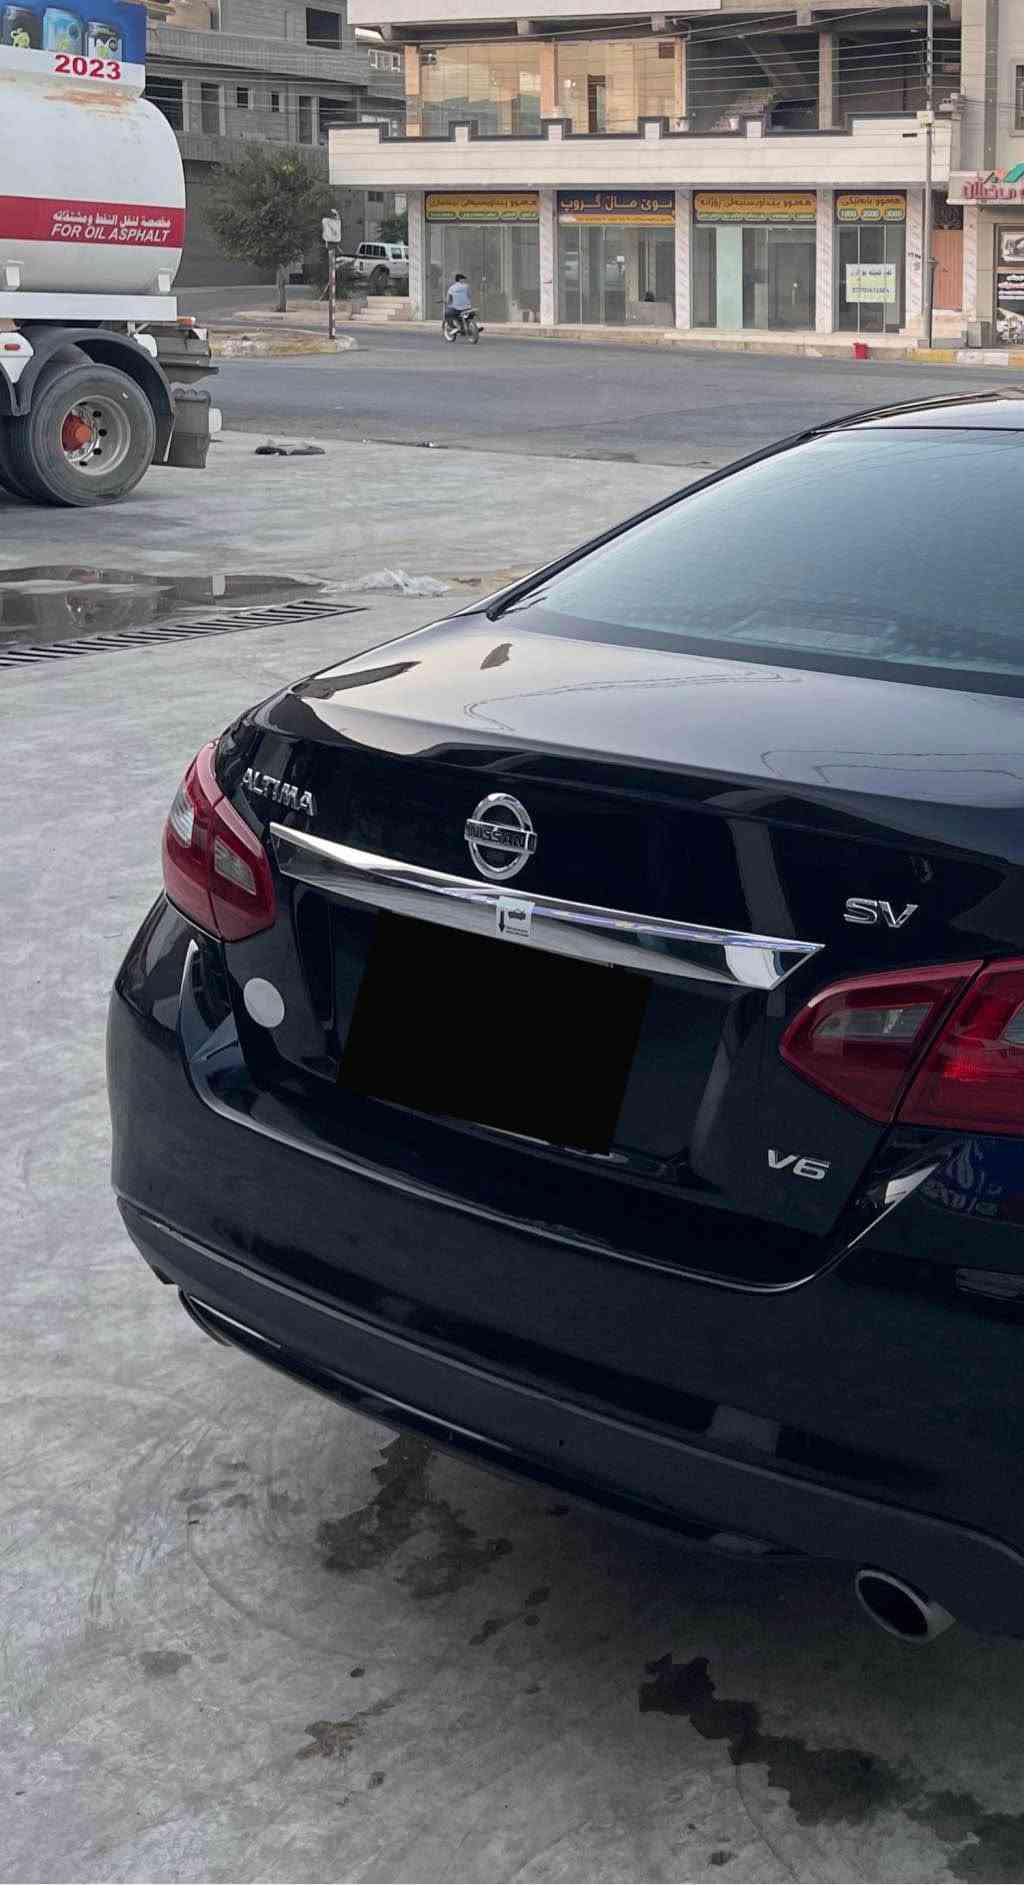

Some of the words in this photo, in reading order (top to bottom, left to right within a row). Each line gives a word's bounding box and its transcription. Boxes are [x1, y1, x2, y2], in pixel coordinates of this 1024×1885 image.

[54, 53, 121, 81] 2023
[51, 223, 82, 238] FOR
[84, 225, 107, 240] OIL
[108, 227, 171, 243] ASPHALT
[242, 767, 315, 817] ALTIMA
[468, 821, 533, 851] NISSAN
[843, 897, 919, 928] SV
[768, 1148, 830, 1180] V6
